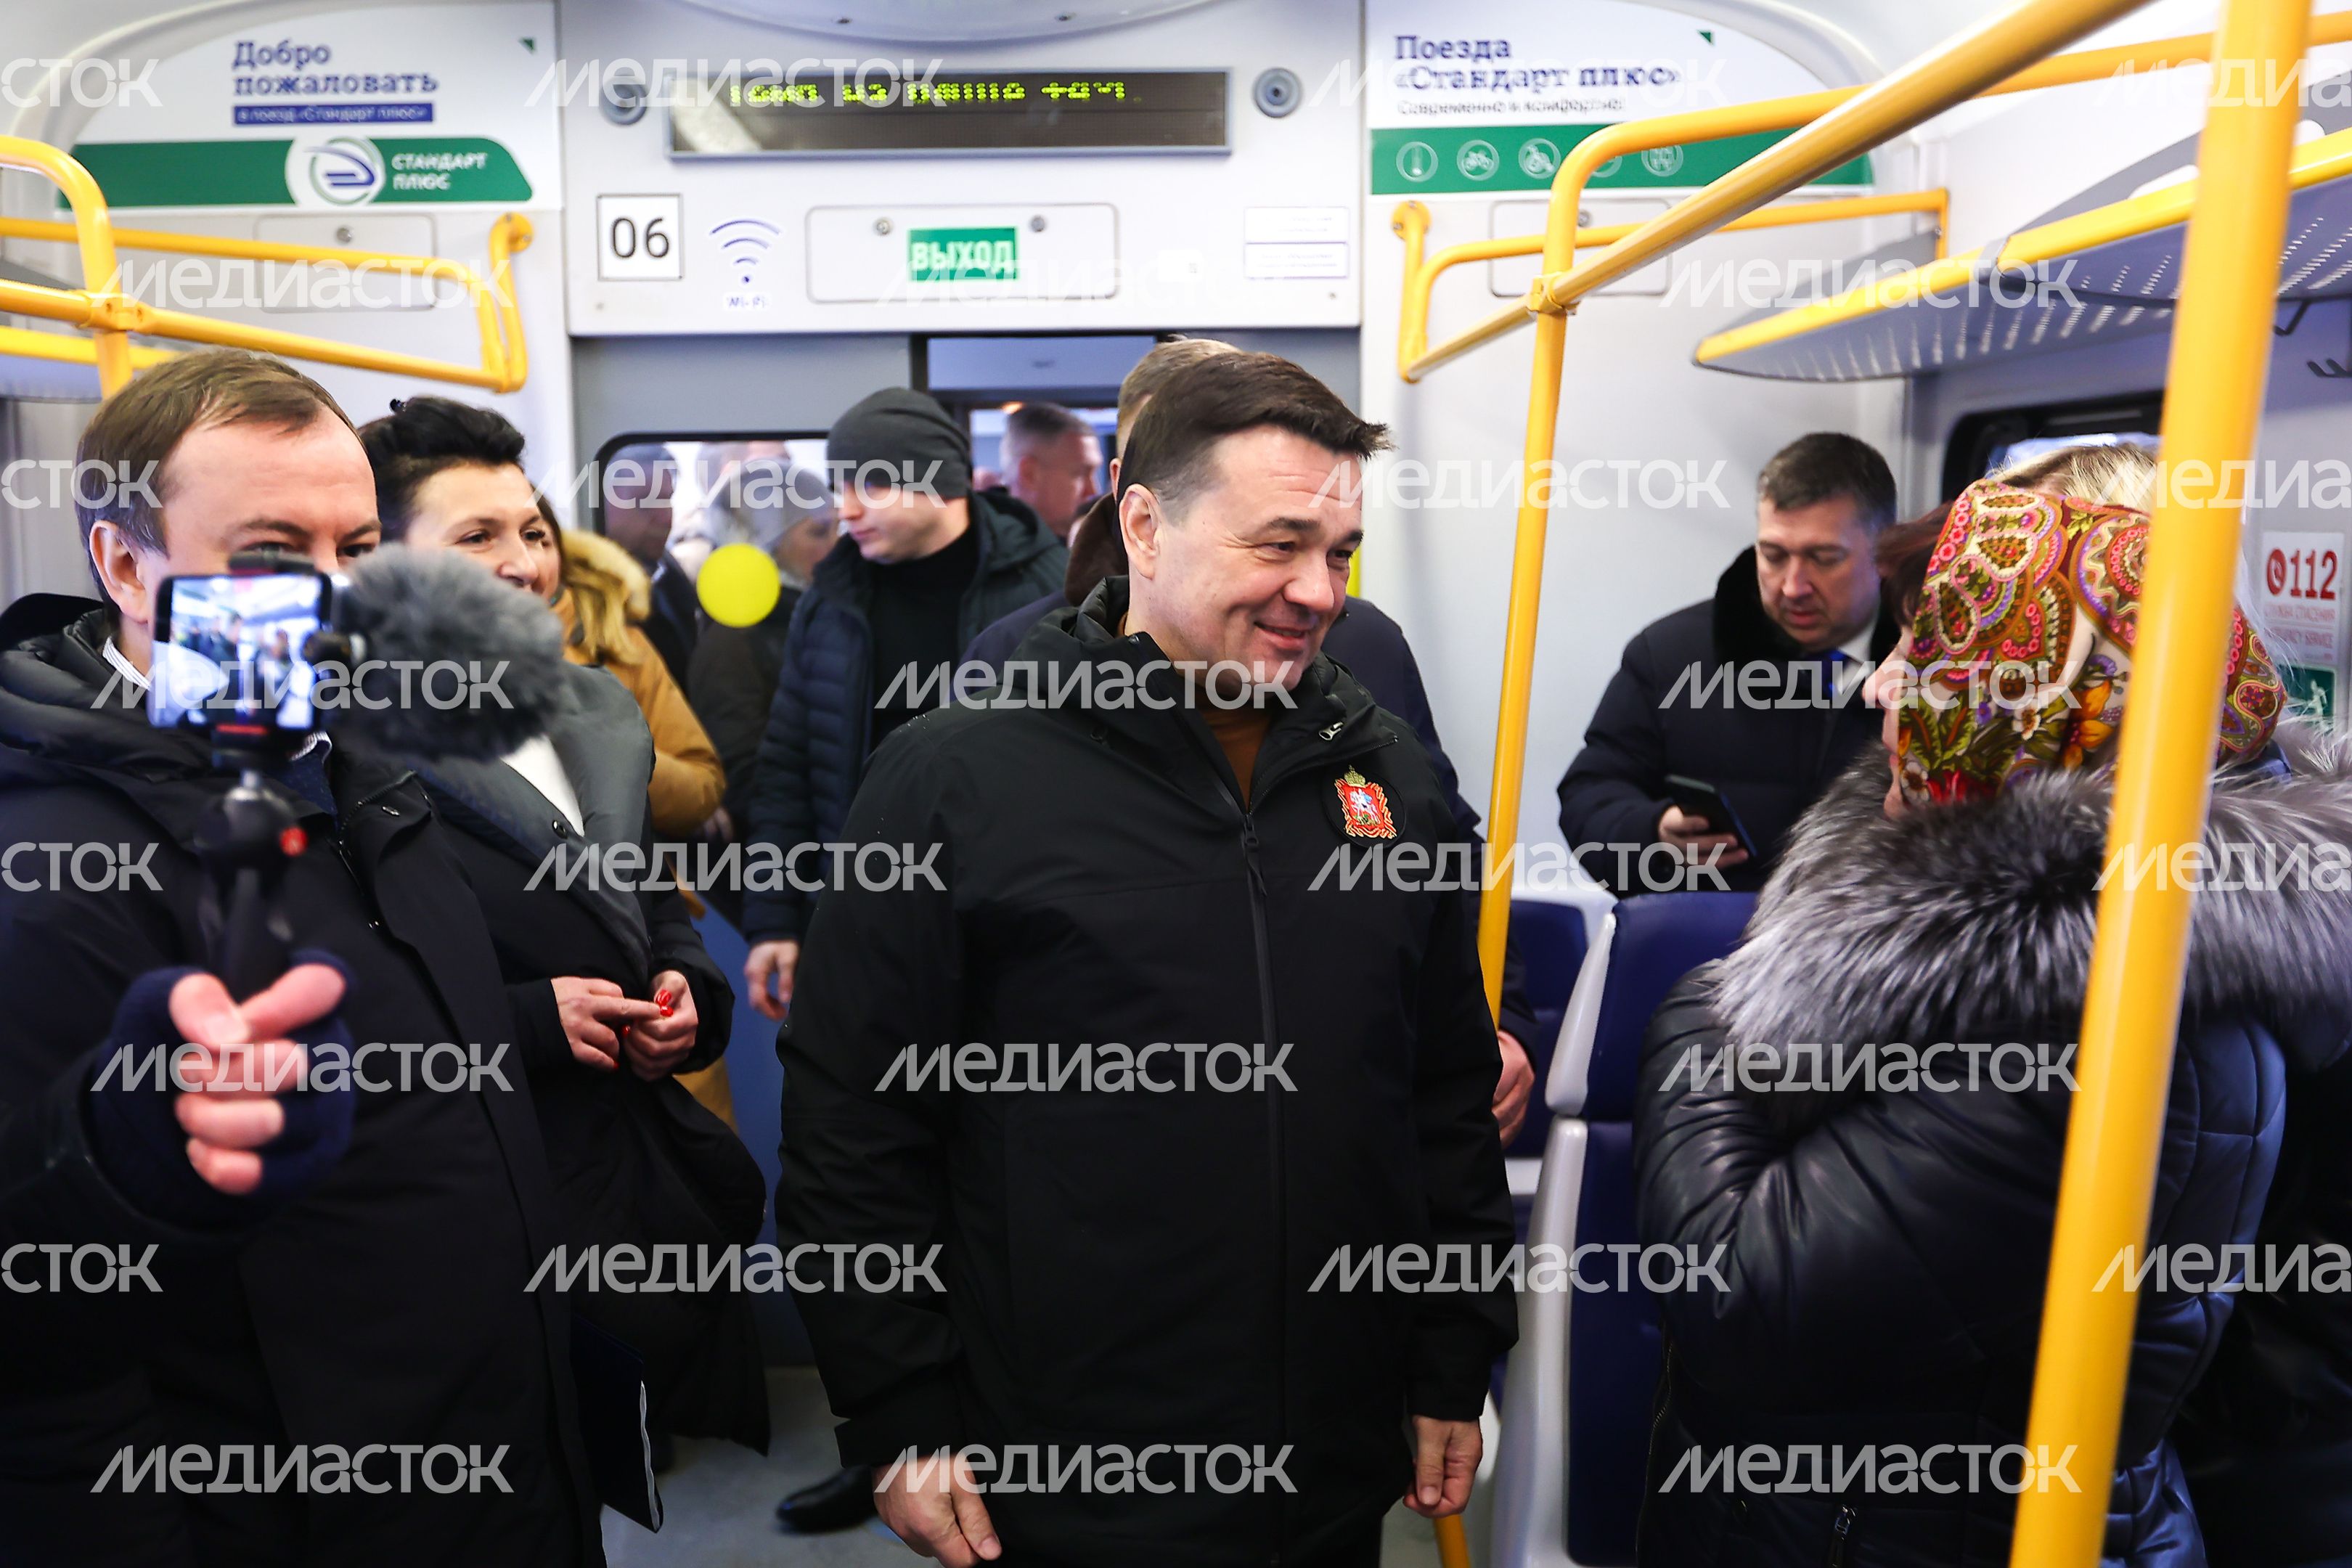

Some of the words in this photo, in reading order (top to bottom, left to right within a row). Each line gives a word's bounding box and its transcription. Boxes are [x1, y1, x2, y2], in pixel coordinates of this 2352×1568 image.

[232, 40, 331, 71] Добро
[1395, 35, 1511, 63] Поезда
[234, 73, 439, 96] пожаловать
[1394, 65, 1569, 94] «Стандарт
[1578, 66, 1683, 86] плюс»
[391, 152, 489, 171] СТАНДАРТ
[392, 173, 452, 191] ПЛЮС
[611, 217, 669, 258] 06
[911, 240, 1014, 274] ВЫХОД
[2290, 548, 2338, 600] 112
